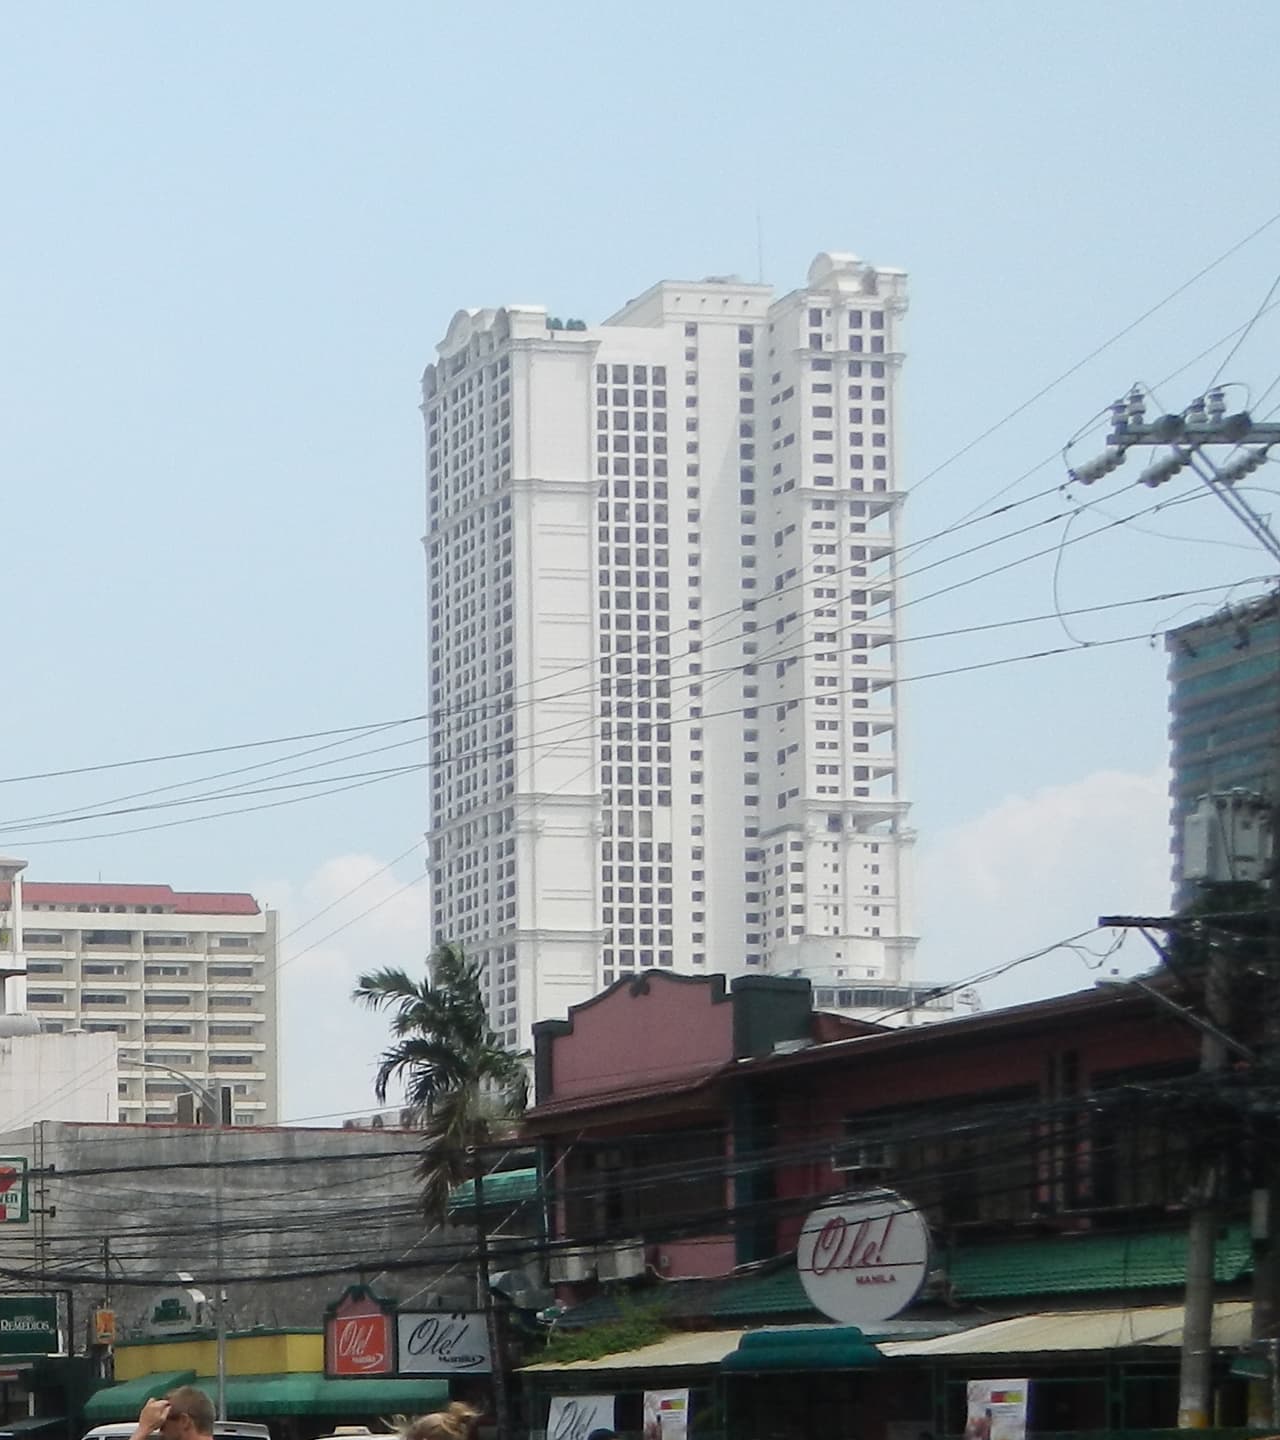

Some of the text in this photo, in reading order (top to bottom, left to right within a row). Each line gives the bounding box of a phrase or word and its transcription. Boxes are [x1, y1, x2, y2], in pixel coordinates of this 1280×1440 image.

[855, 1274, 897, 1285] MANILA
[0, 1318, 49, 1332] REMEDIOS
[407, 1317, 470, 1356] Ole!
